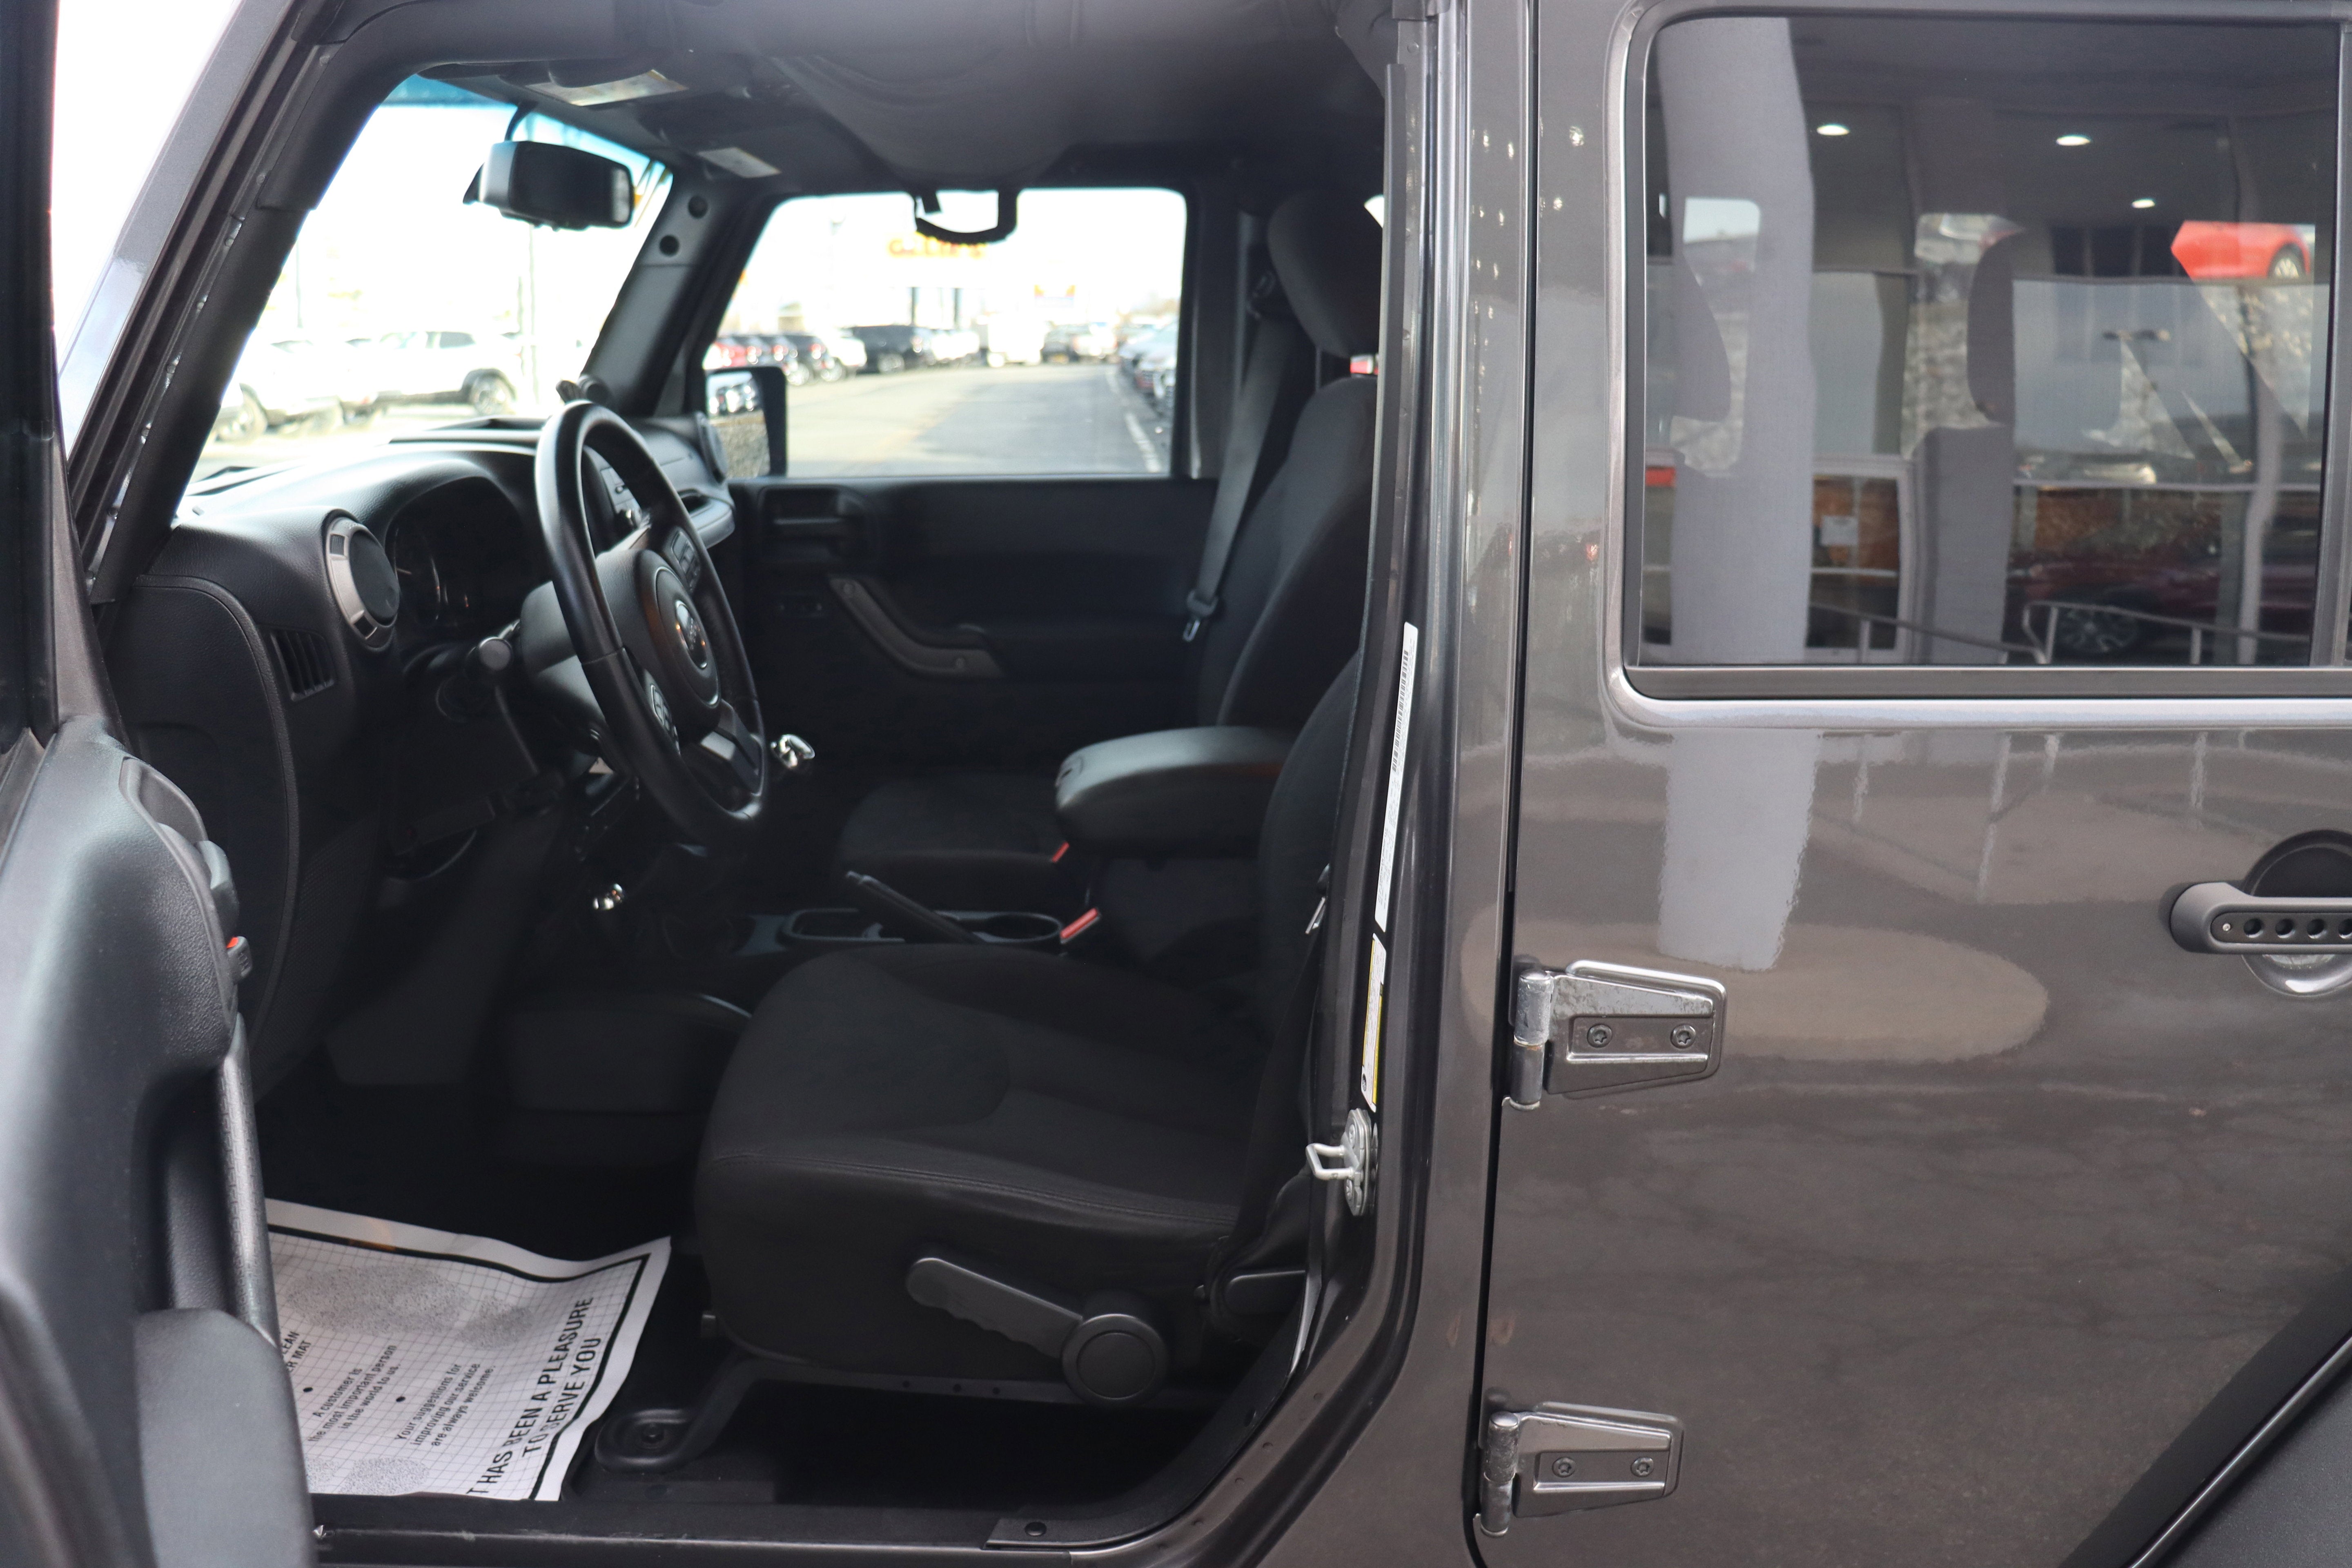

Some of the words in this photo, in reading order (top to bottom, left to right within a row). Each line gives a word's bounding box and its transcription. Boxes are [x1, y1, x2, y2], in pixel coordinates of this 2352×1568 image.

[292, 1341, 311, 1359] MAT
[537, 1297, 594, 1385] PLEASURE
[307, 1431, 326, 1441] the
[323, 1411, 345, 1429] most
[337, 1373, 376, 1409] important
[372, 1345, 397, 1372] person
[321, 1376, 355, 1411] customer
[347, 1408, 364, 1421] the
[360, 1386, 383, 1406] world
[394, 1422, 417, 1440] Your
[413, 1377, 453, 1421] suggestions
[445, 1364, 461, 1375] for
[410, 1406, 451, 1446] improving
[444, 1393, 459, 1405] our
[455, 1363, 480, 1392] service
[431, 1432, 447, 1446] are
[443, 1405, 468, 1432] always
[463, 1365, 496, 1403] welcome.
[522, 1433, 549, 1457] TO
[540, 1381, 585, 1431] SERVE
[571, 1338, 601, 1376] YOU
[531, 1391, 552, 1401] A
[502, 1408, 543, 1447] BEEN
[477, 1450, 512, 1483] HAS
